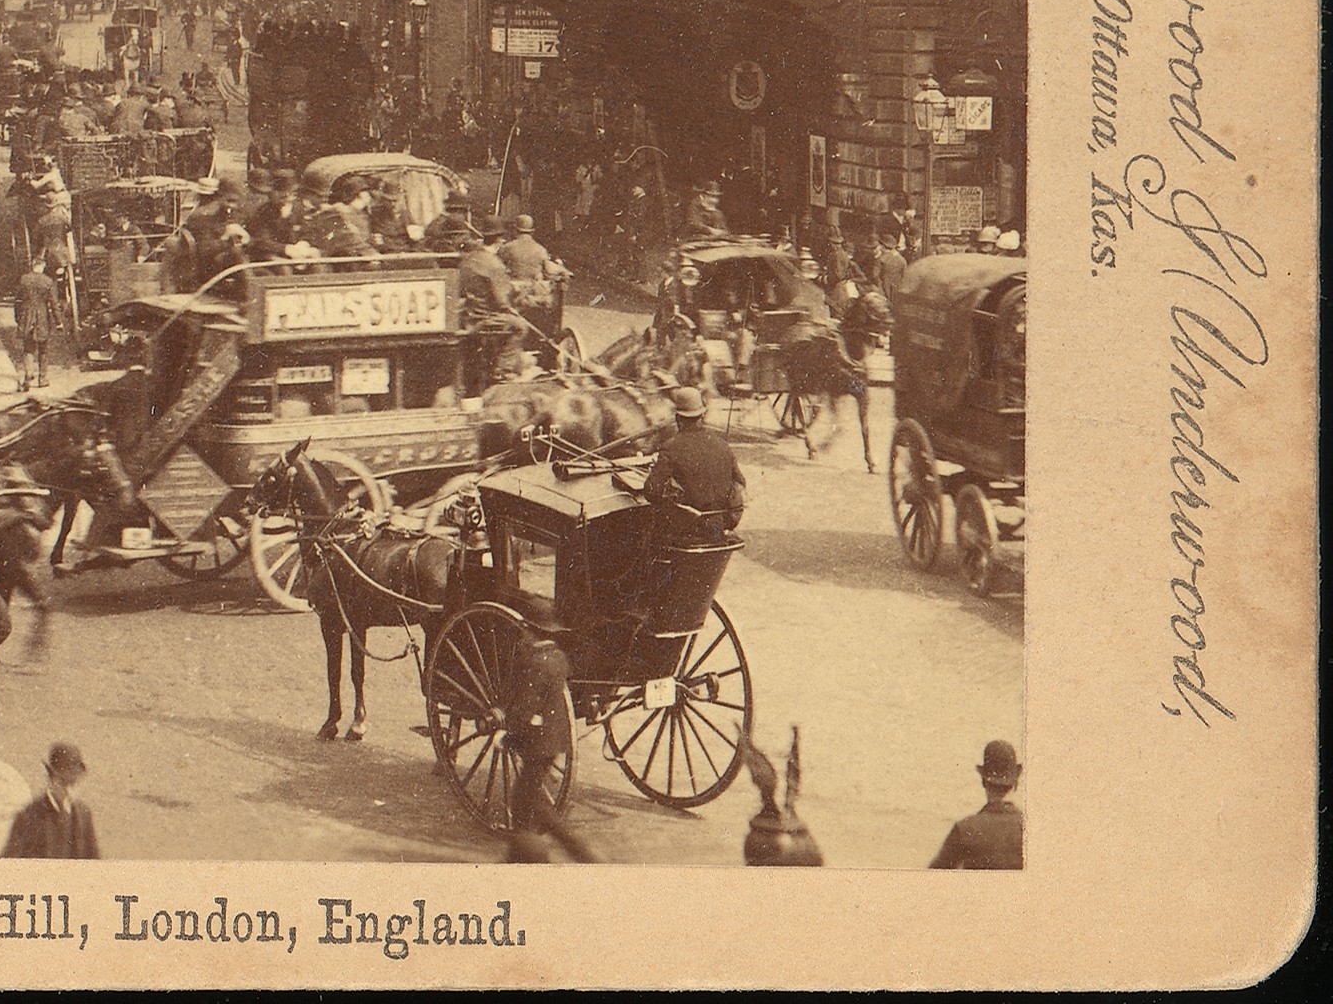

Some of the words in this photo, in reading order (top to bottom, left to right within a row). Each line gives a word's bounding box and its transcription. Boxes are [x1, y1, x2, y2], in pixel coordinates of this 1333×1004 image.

[968, 99, 992, 125] CIGARS
[1090, 171, 1136, 279] Kas.
[371, 289, 440, 327] SOAP
[1161, 270, 1270, 729] Underwood,
[114, 894, 299, 954] London,
[318, 898, 527, 960] England.
